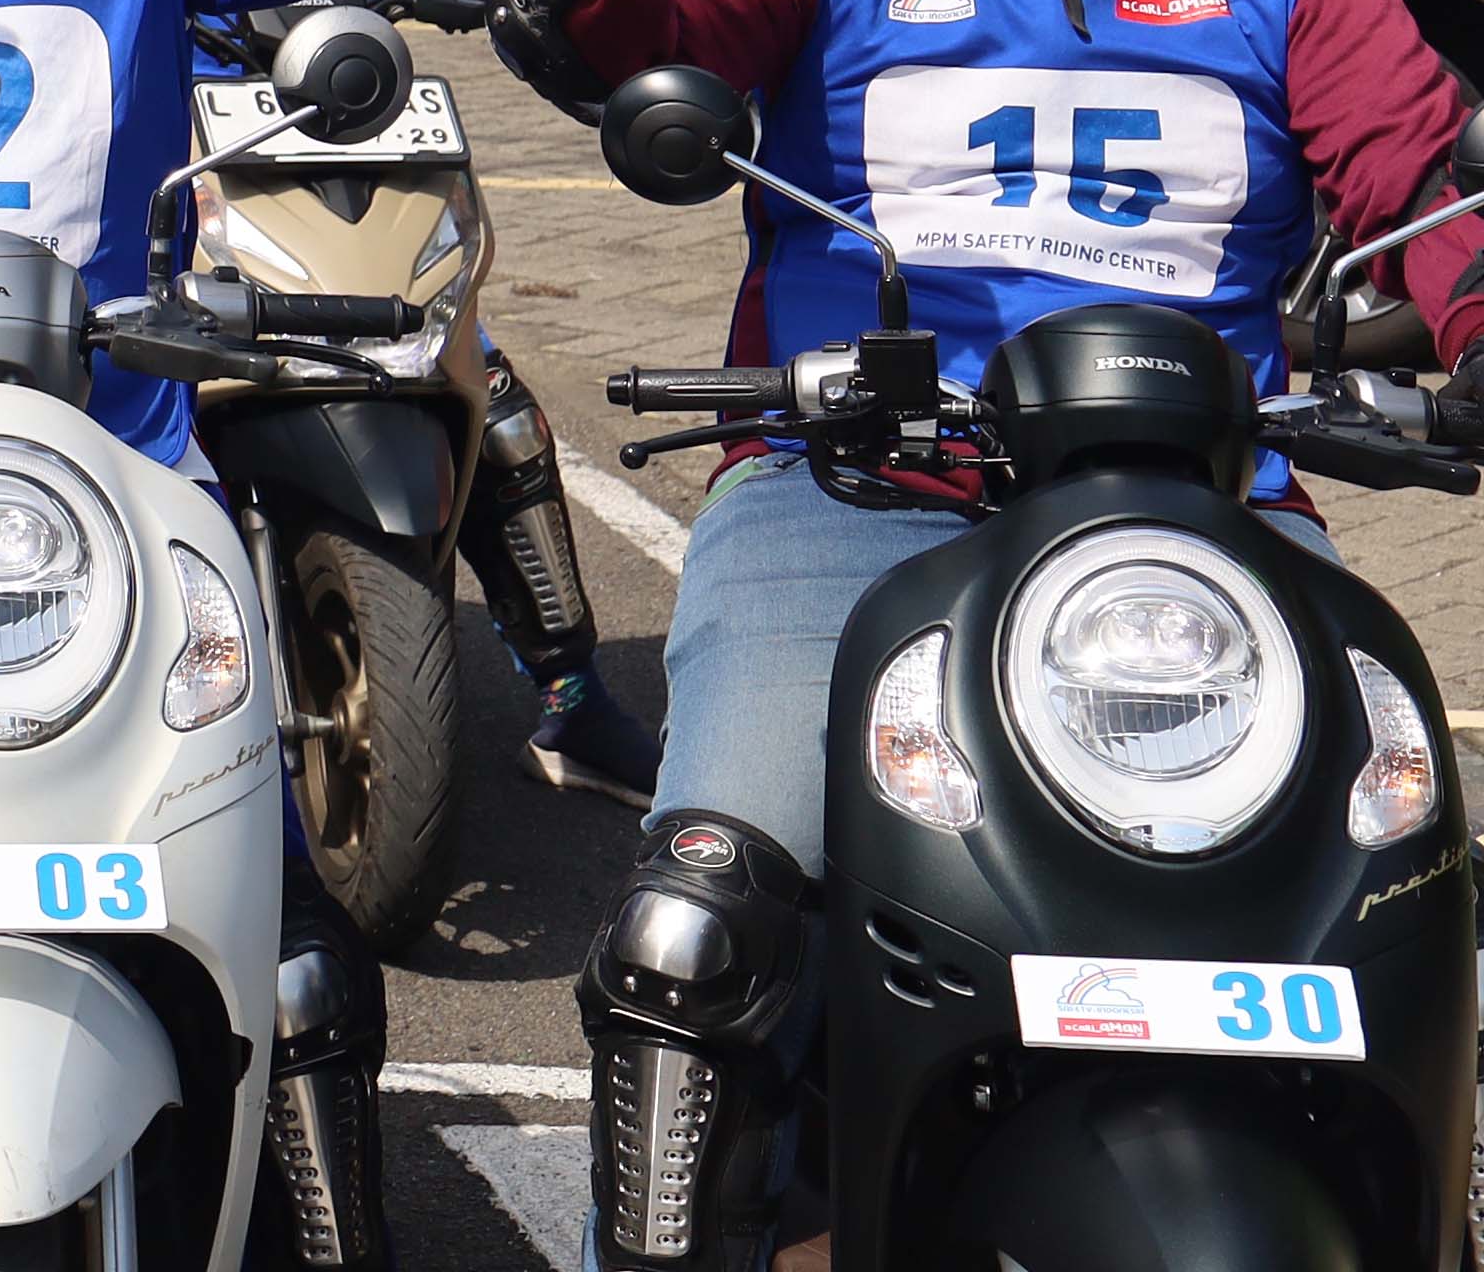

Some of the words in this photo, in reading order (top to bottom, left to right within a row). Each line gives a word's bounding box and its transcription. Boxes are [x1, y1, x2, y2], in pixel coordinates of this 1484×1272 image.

[207, 90, 232, 116] L
[967, 105, 1171, 228] 15
[915, 233, 954, 248] MPM
[963, 233, 1035, 251] SAFETY
[1040, 237, 1104, 264] RIDING
[1108, 252, 1177, 280] CENTER
[1094, 355, 1193, 377] HONDA
[35, 852, 148, 920] 03
[1357, 845, 1470, 922] prestig
[1213, 971, 1344, 1044] 30
